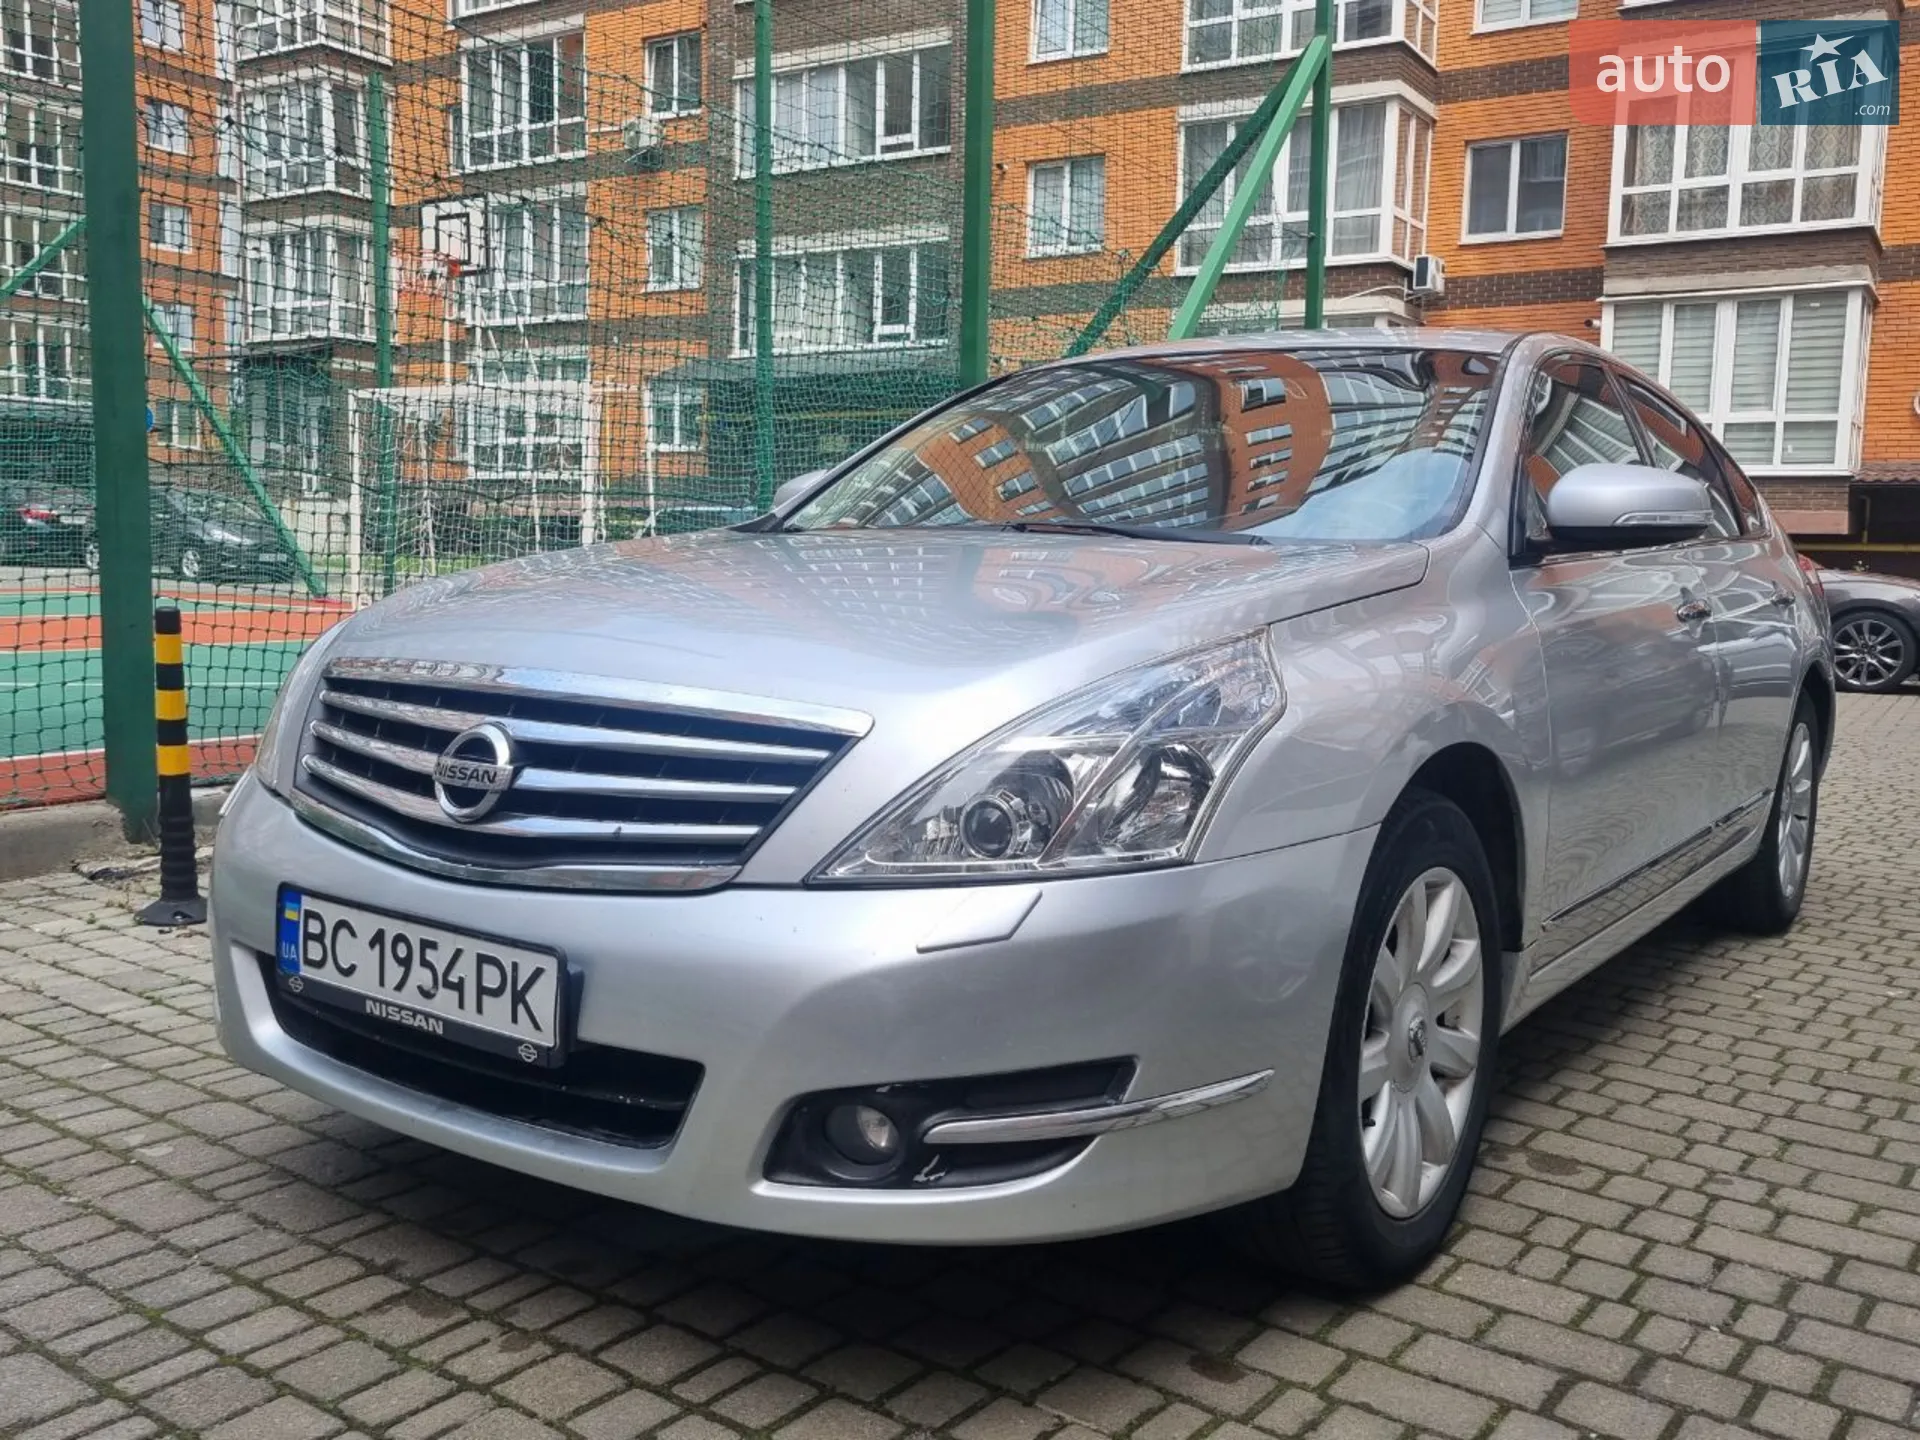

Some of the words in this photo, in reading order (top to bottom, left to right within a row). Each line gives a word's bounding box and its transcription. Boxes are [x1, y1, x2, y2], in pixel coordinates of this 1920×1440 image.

[434, 760, 498, 784] NISSAN
[281, 942, 298, 962] UA
[365, 999, 444, 1035] NISSAN
